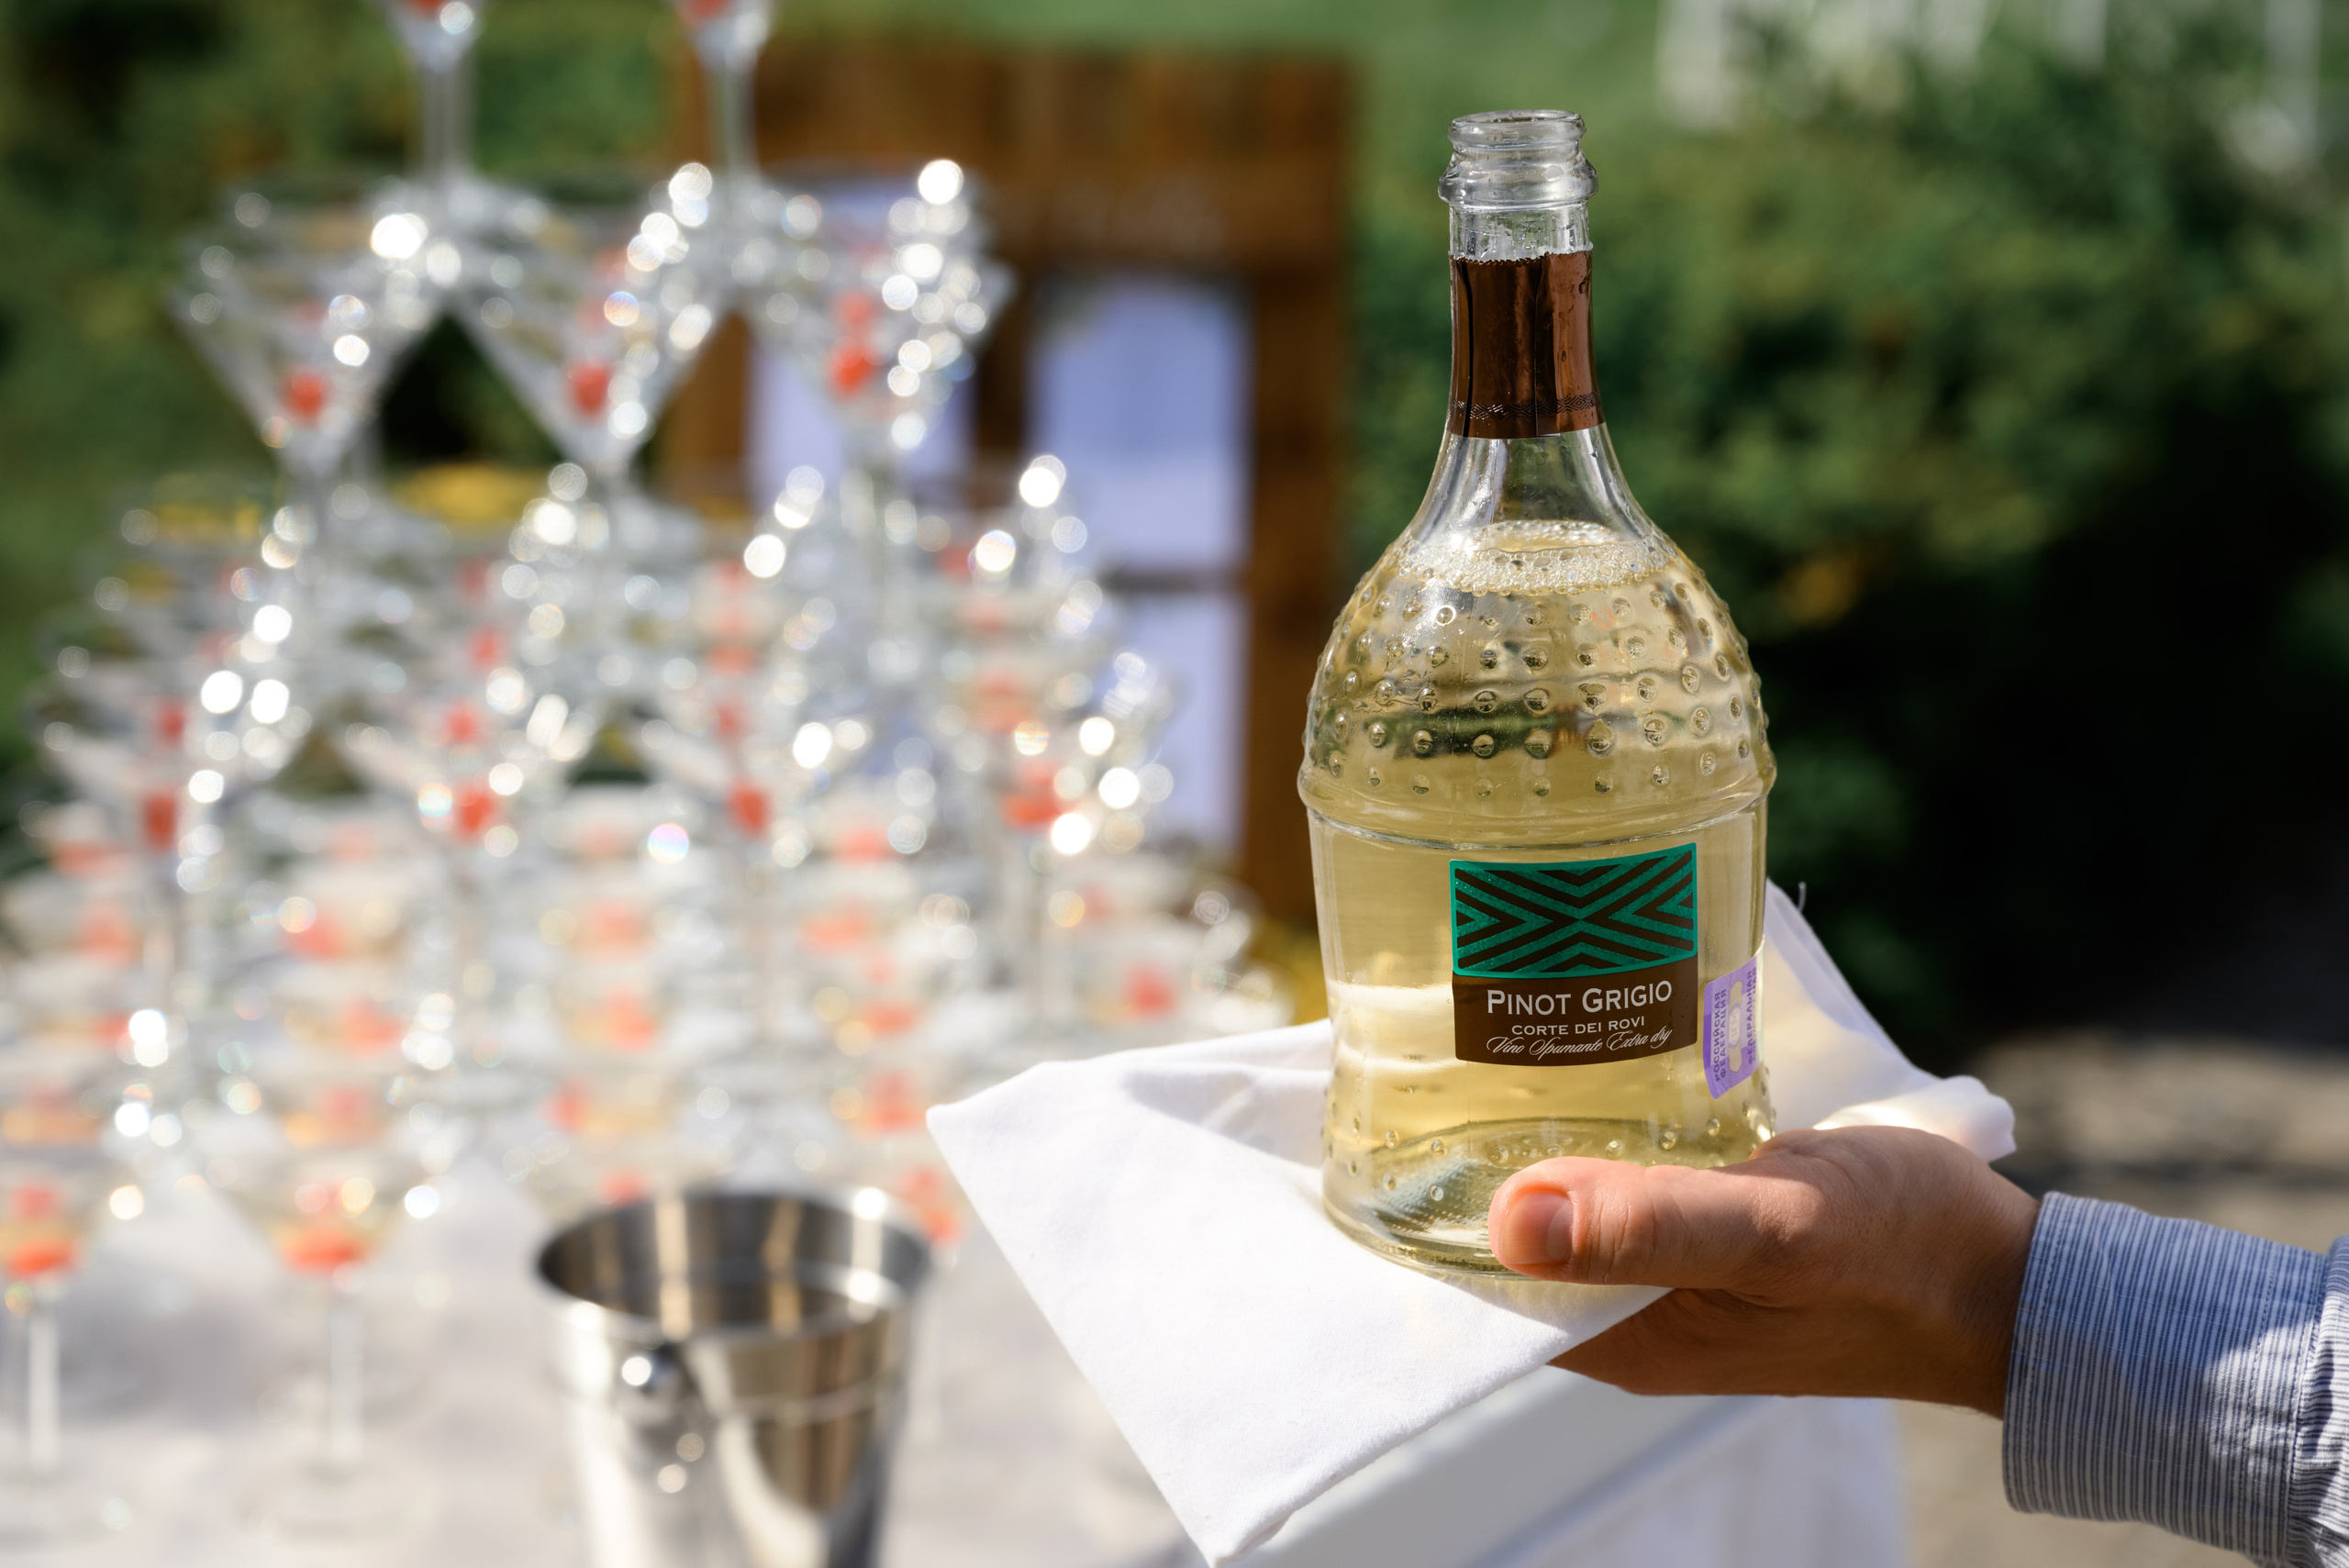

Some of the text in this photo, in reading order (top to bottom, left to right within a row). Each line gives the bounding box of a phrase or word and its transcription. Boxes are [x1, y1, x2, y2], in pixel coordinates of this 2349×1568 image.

[1486, 980, 1673, 1016] PINOT GRIGIO
[1486, 1025, 1673, 1061] Vino Spumante Extra dry
[1511, 1016, 1645, 1036] CORTE DEI ROVI
[1712, 992, 1721, 1082] РОССИЙСКАЯ
